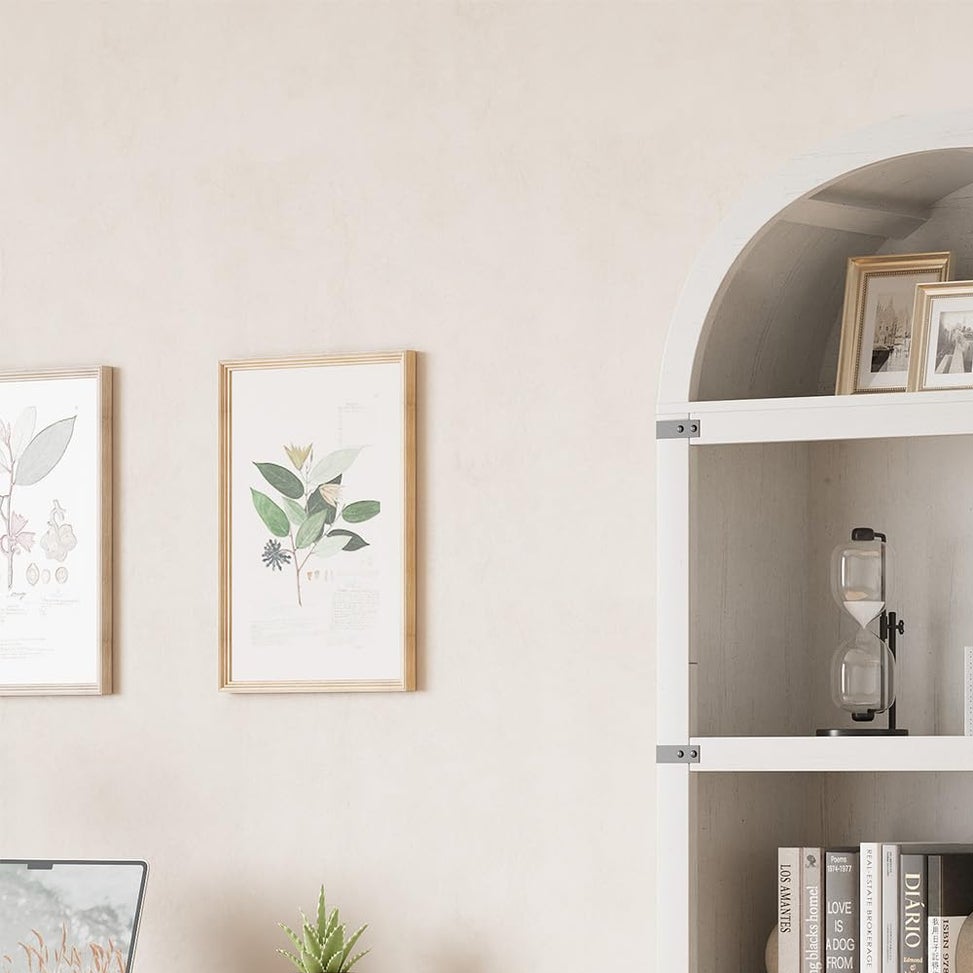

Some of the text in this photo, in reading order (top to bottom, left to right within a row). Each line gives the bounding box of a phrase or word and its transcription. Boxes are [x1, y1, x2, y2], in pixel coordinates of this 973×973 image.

[831, 855, 848, 863] Poems
[780, 864, 792, 934] LOS AMANTES
[805, 885, 819, 922] home!
[827, 901, 852, 915] LOVE
[904, 873, 925, 948] DIÁRIO
[835, 920, 843, 933] IS
[942, 919, 950, 949] ISBN
[805, 924, 819, 960] blacks
[826, 938, 855, 951] A DOG
[826, 956, 854, 970] FROM
[903, 956, 923, 964] Edmond
